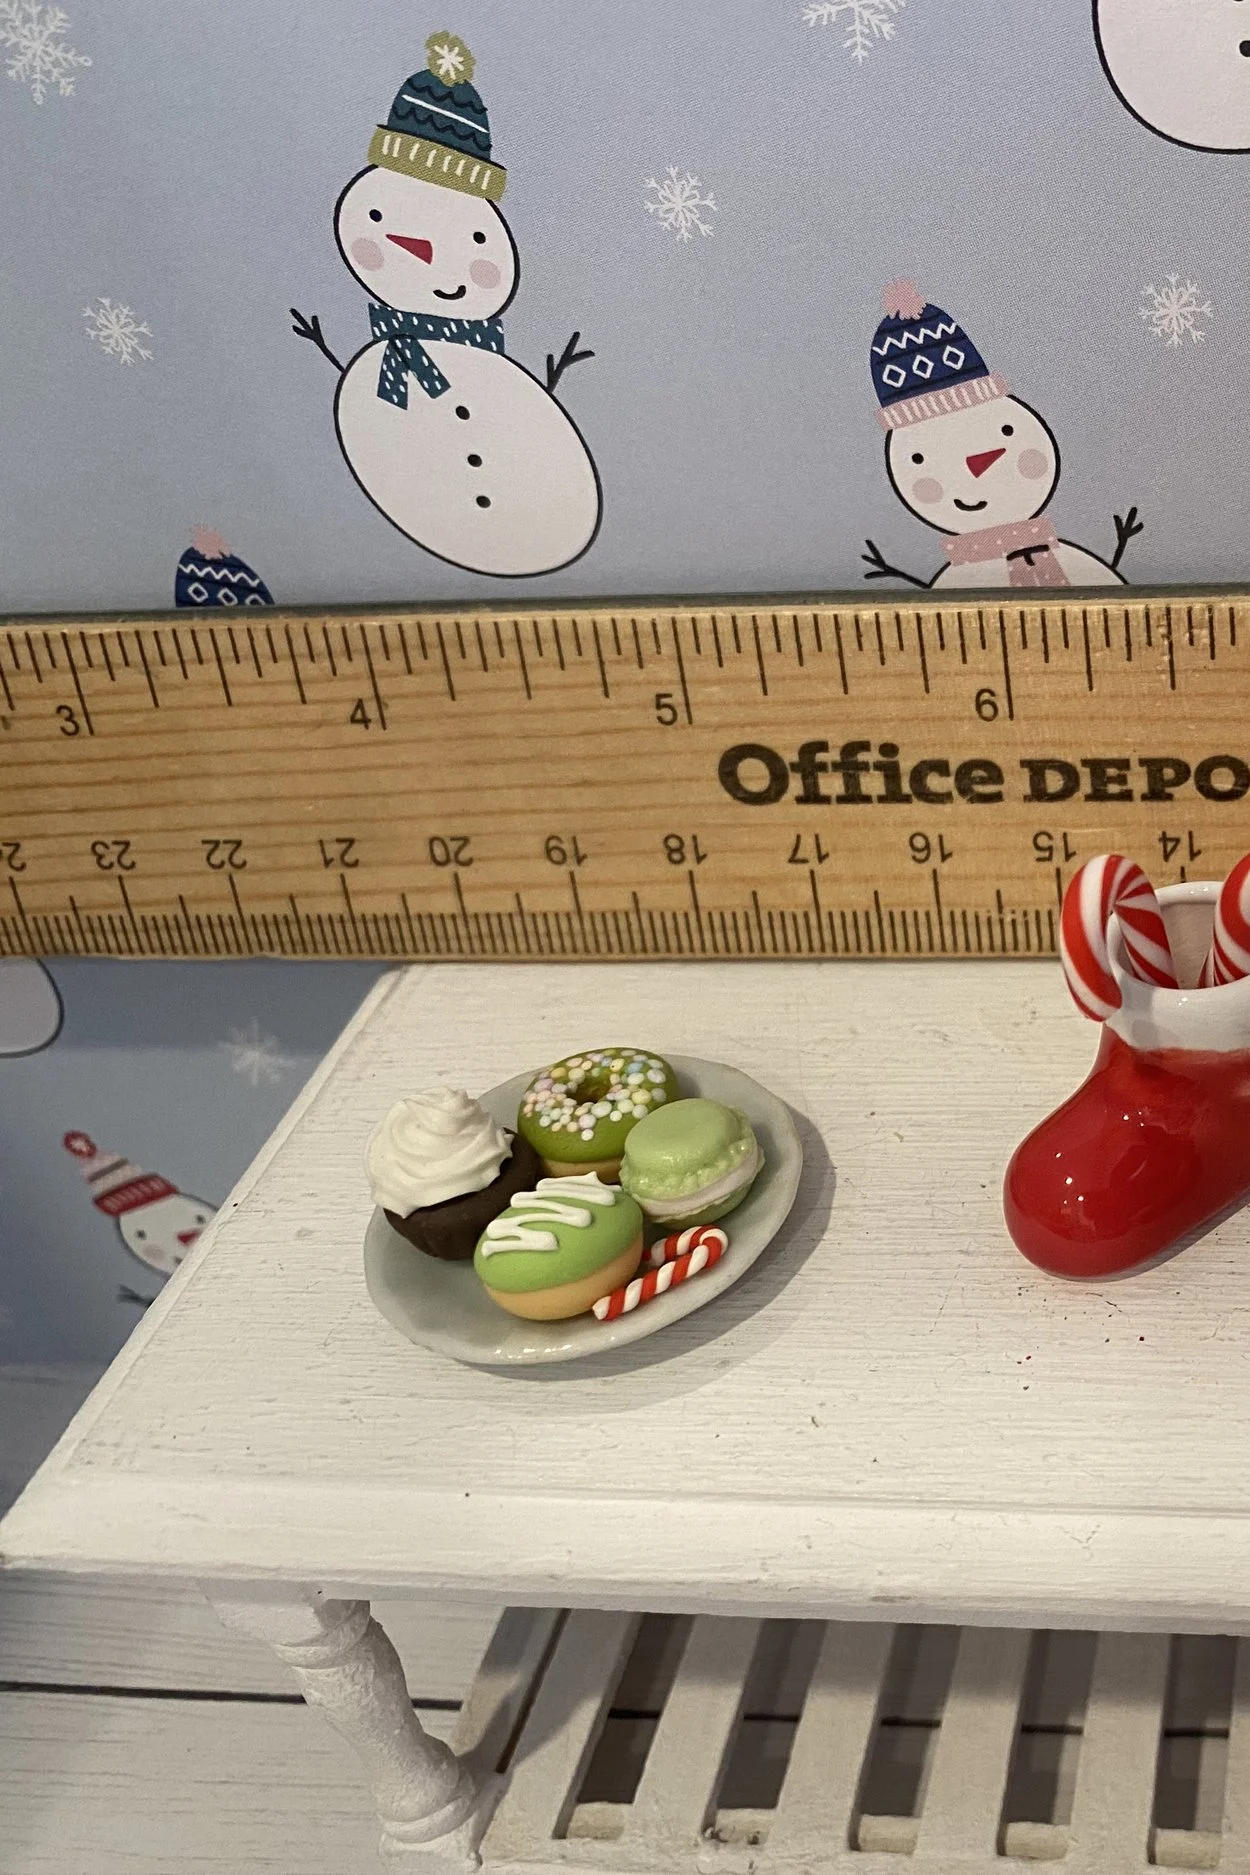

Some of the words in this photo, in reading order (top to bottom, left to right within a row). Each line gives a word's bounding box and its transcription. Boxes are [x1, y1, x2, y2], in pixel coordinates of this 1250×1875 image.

[55, 703, 80, 737] 3
[349, 698, 373, 731] 4
[654, 692, 678, 727] 5
[974, 688, 999, 723] 6
[717, 740, 1005, 807] Office
[0, 841, 27, 872] 2
[90, 840, 137, 871] 23
[201, 839, 247, 870] 22
[317, 837, 360, 869] 21
[428, 835, 475, 868] 20
[544, 834, 588, 867] 19
[662, 833, 708, 866] 18
[787, 833, 830, 865] 17
[908, 831, 954, 865] 16
[1032, 830, 1077, 863] 15
[1158, 830, 1203, 863] 14
